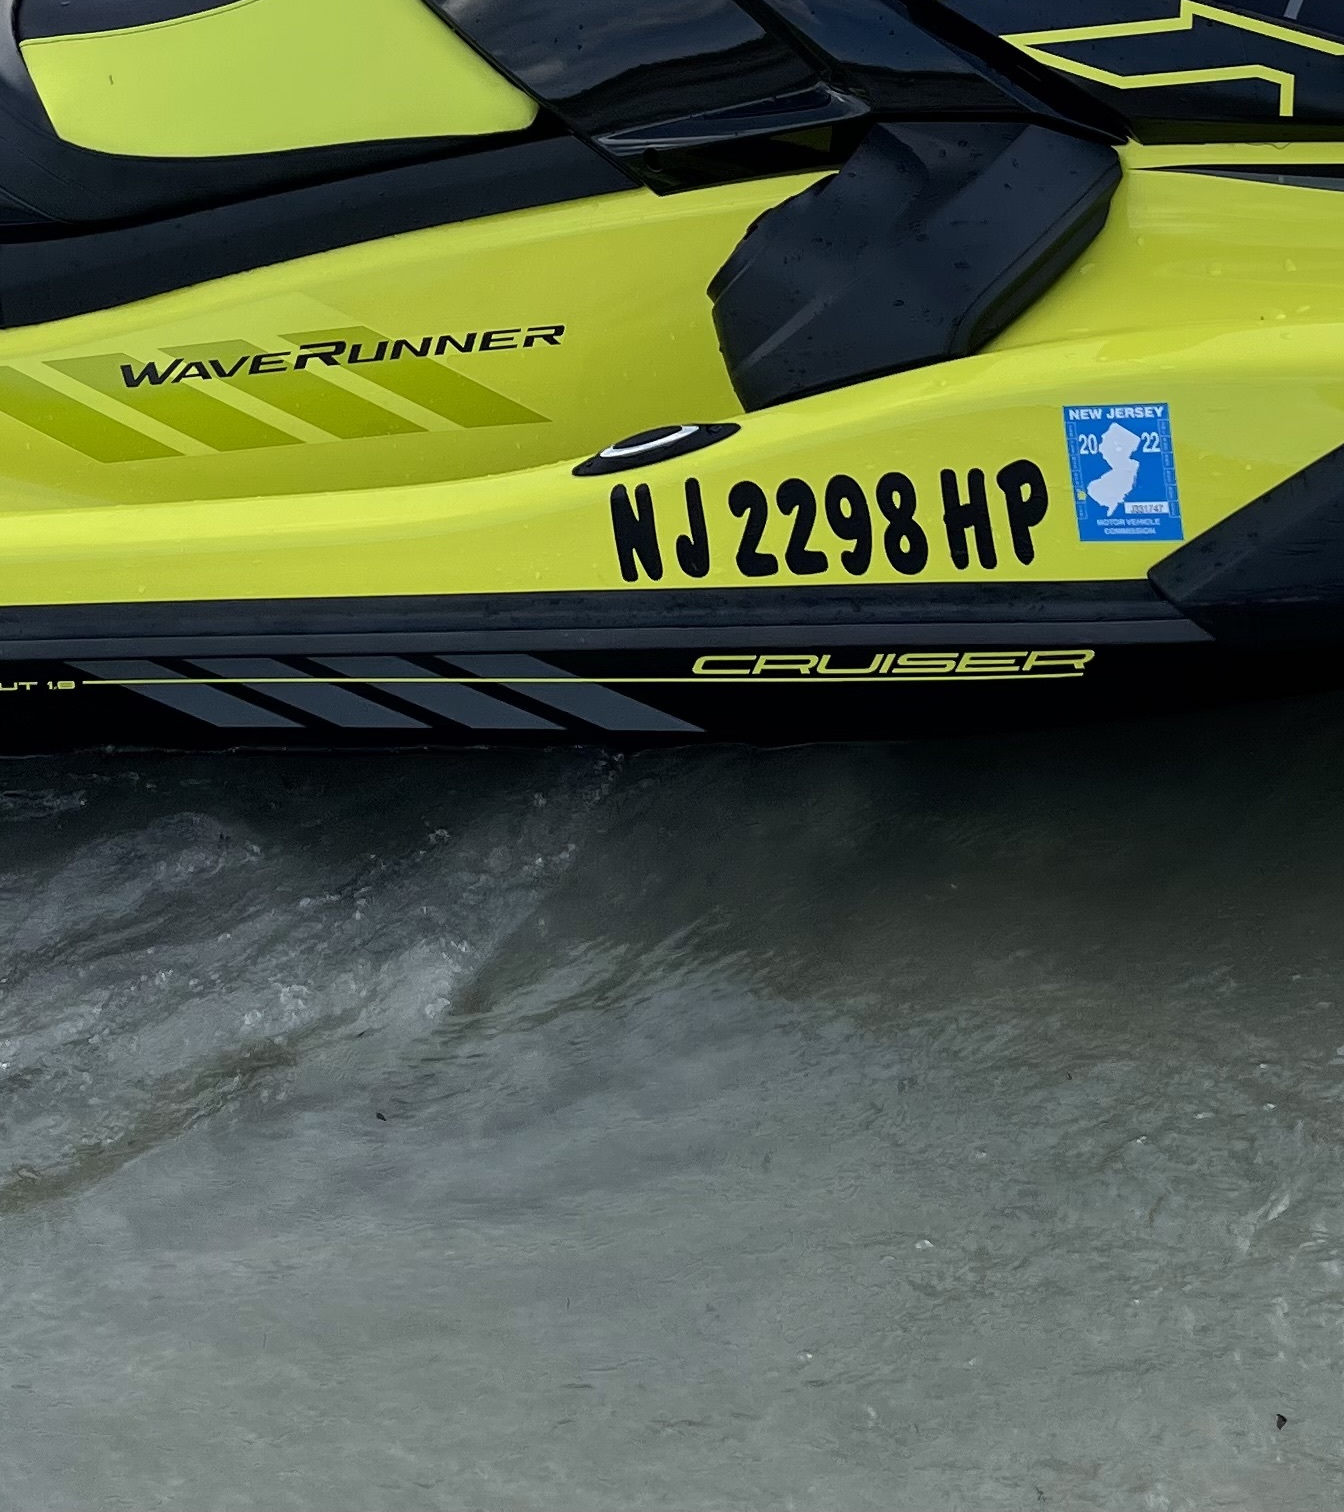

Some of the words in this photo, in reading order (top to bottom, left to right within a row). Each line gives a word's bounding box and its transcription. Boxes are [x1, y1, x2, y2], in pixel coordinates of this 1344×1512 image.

[1068, 408, 1103, 421] NEW
[1106, 406, 1164, 419] JERSEY
[1078, 433, 1099, 455] 20
[1141, 431, 1161, 453] 22
[610, 477, 710, 582] NJ
[728, 471, 929, 577] 2298
[942, 459, 1049, 570] HP
[692, 649, 1095, 675] CRUISER
